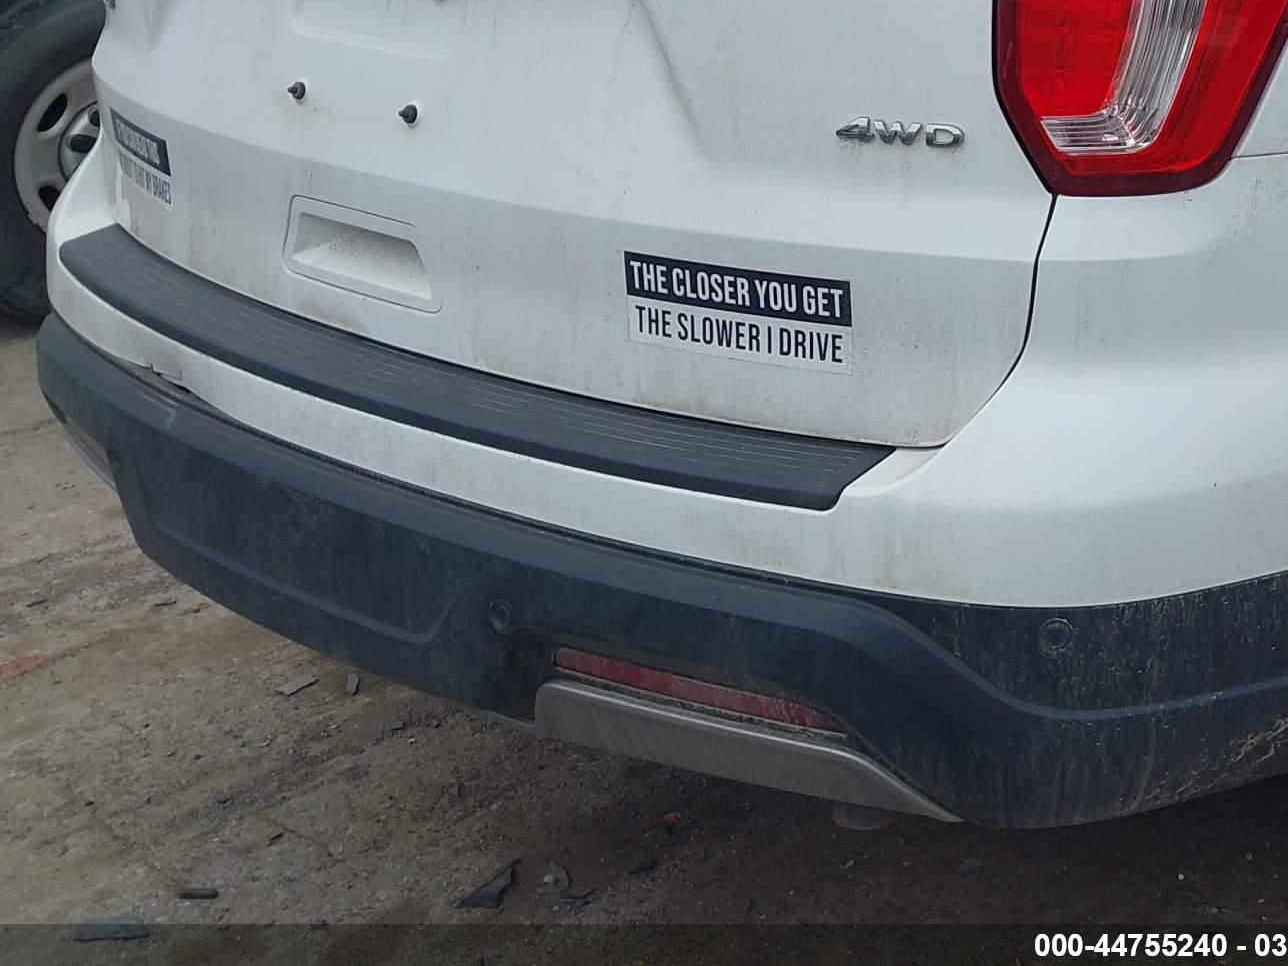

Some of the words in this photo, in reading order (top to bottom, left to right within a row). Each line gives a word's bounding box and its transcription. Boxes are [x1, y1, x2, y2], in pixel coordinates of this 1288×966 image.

[836, 116, 965, 148] 4WD
[629, 260, 669, 294] THE
[671, 267, 751, 308] CLOSER
[754, 279, 797, 313] YOU
[802, 285, 843, 318] GET
[635, 305, 672, 338] THE
[677, 312, 760, 353] SLOWER
[767, 325, 772, 354] I
[779, 327, 843, 363] DRIVE
